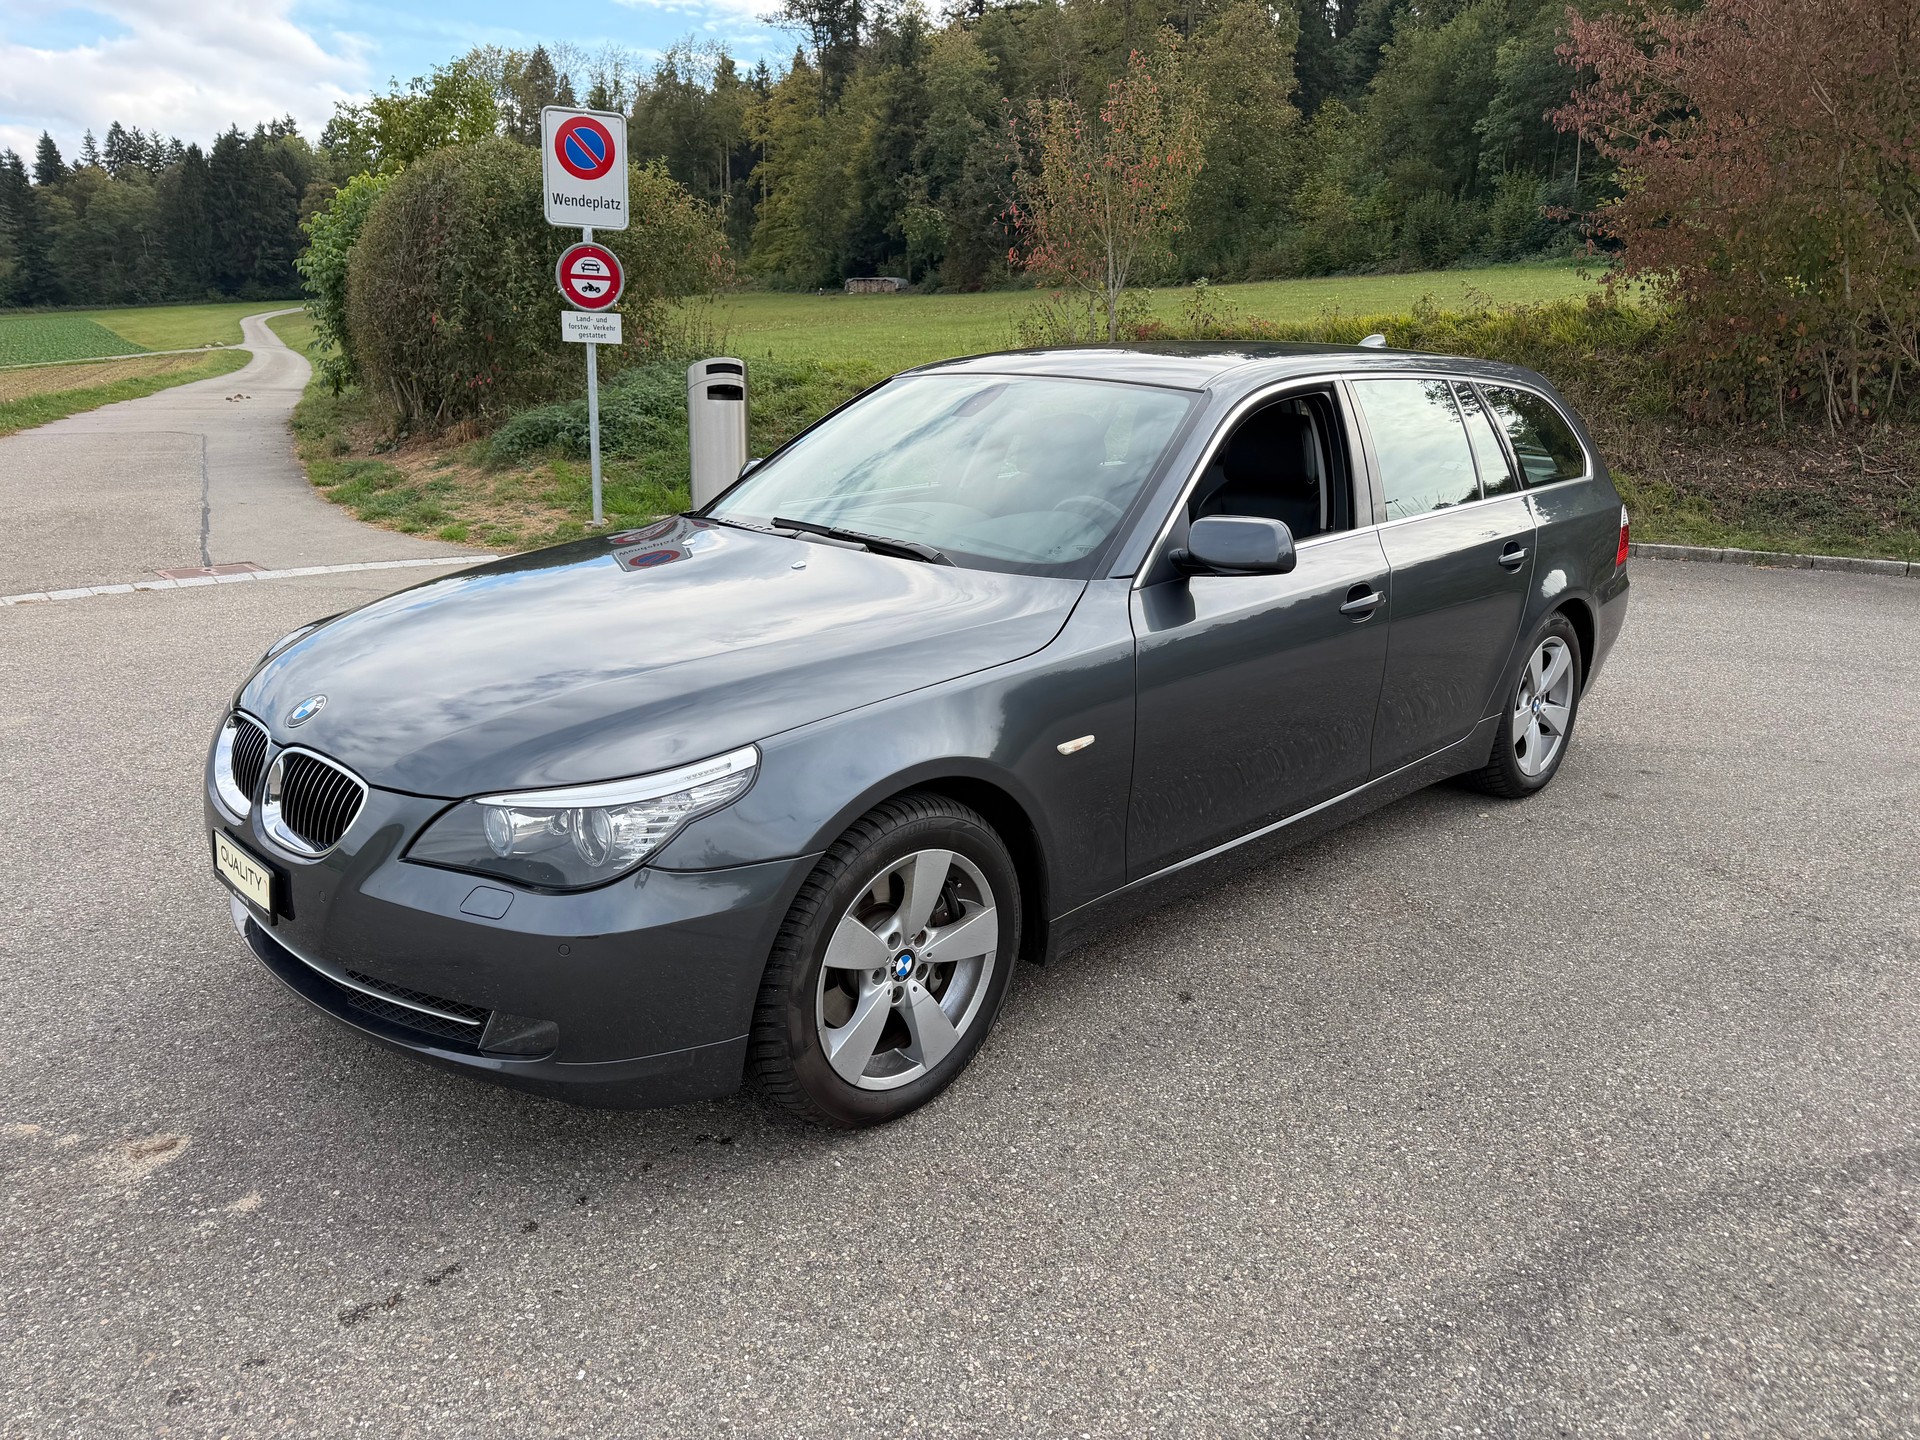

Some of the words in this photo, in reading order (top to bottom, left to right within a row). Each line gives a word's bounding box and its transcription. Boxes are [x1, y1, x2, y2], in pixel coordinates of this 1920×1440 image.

[552, 192, 621, 212] Wendeplatz
[576, 315, 593, 323] Land-
[220, 845, 262, 891] QUALITY
